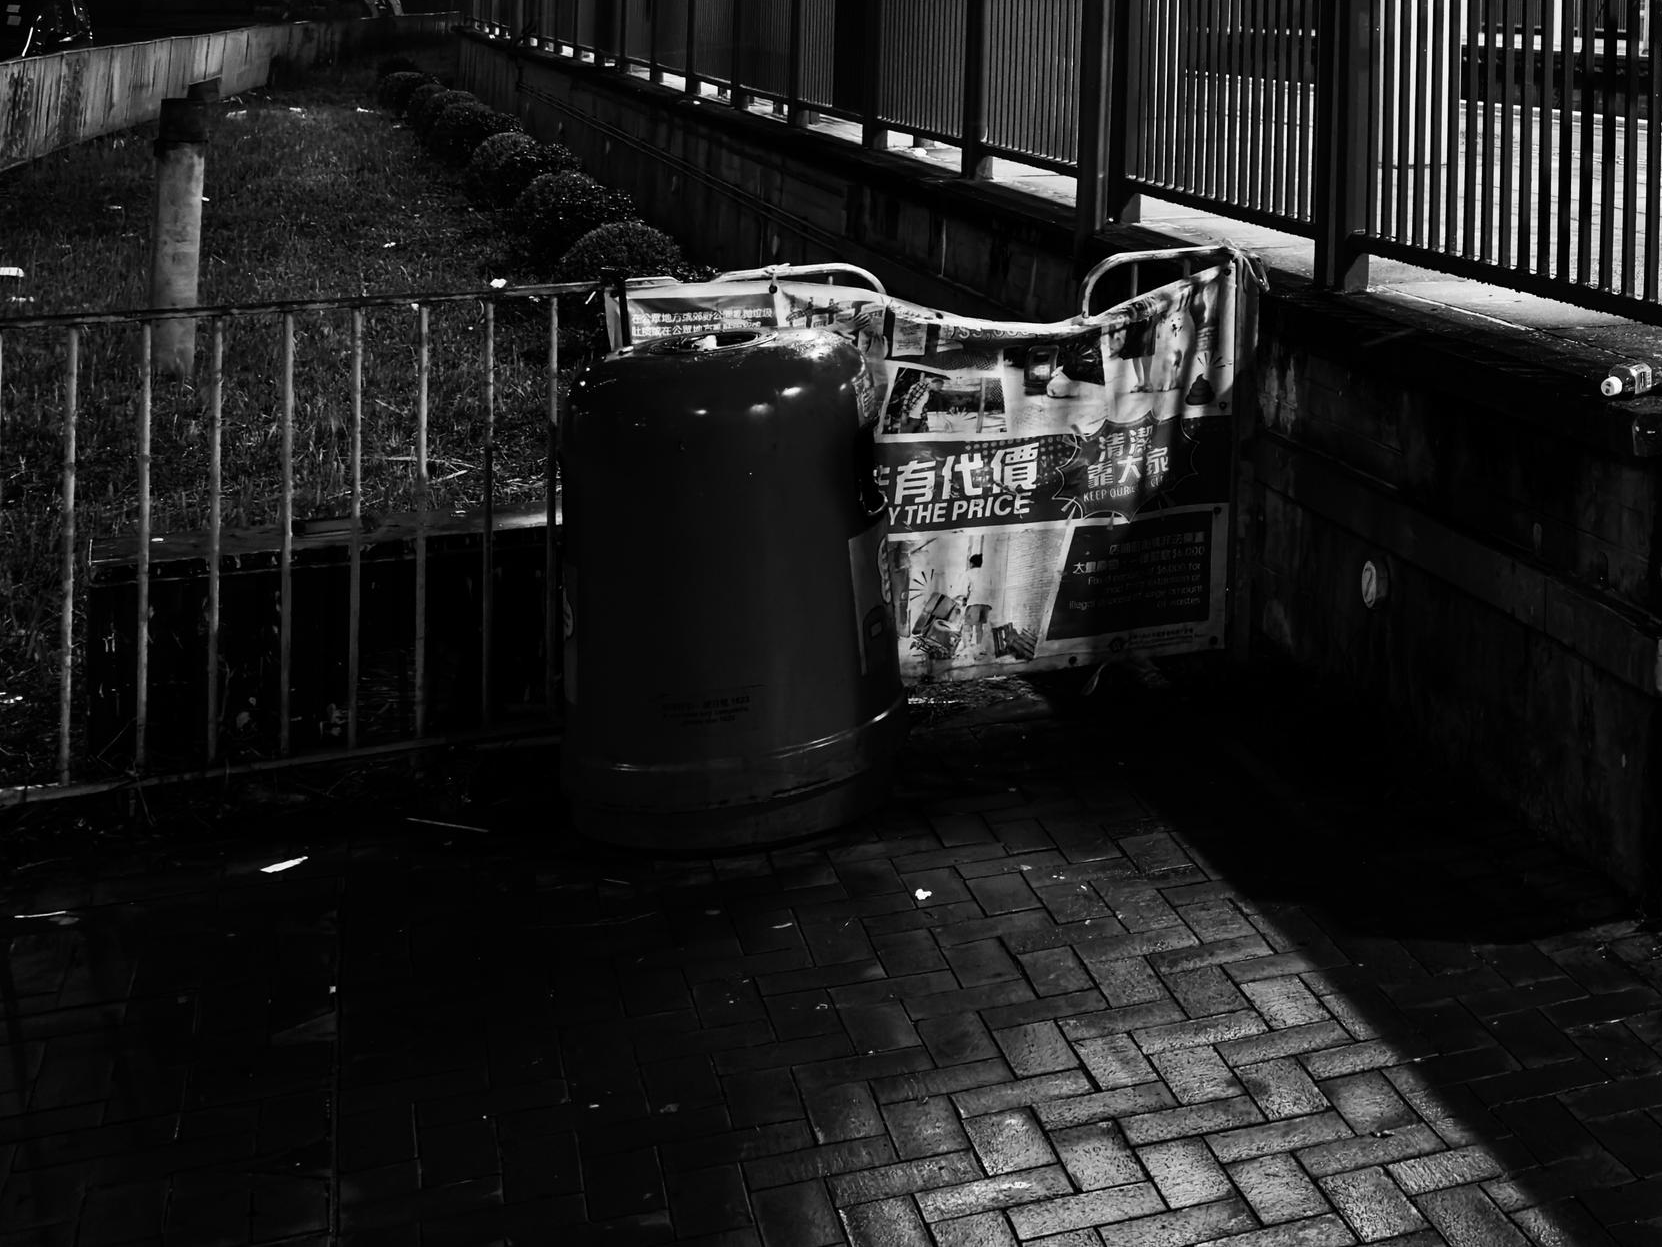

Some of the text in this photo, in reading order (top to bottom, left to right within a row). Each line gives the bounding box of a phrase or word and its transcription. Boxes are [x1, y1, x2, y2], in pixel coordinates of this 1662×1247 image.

[1098, 425, 1154, 463] 清潔
[1087, 446, 1170, 489] 靠大家
[903, 502, 948, 526] THE
[951, 491, 1033, 521] PRICE
[1083, 489, 1107, 503] KEEP
[1109, 485, 1131, 499] OUR
